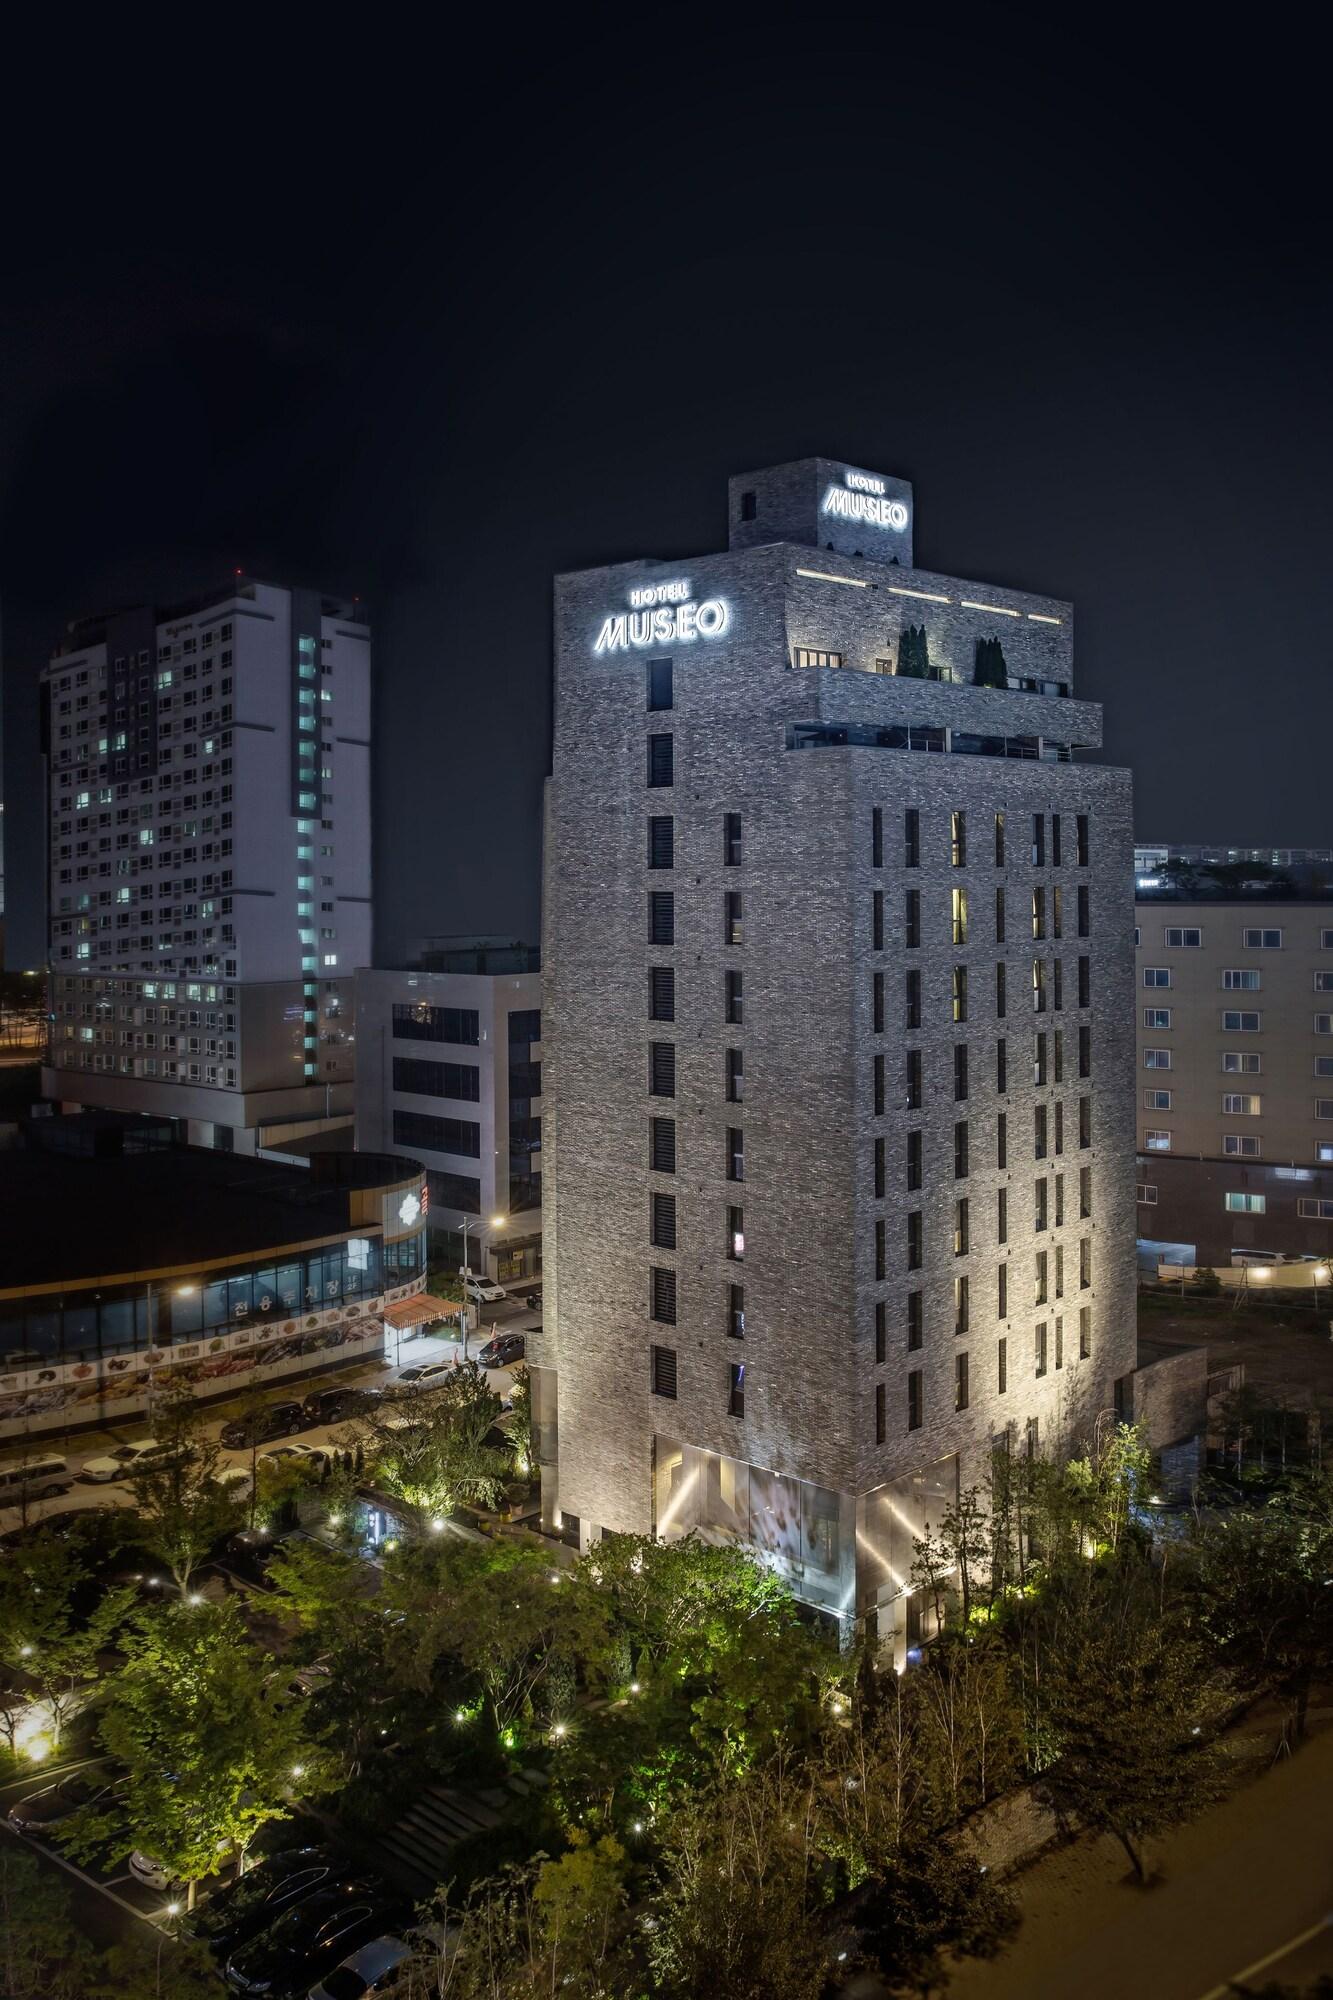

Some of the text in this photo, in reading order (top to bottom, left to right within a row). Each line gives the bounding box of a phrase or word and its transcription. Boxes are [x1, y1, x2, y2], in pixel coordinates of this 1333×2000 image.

[846, 473, 886, 495] HOTEL
[824, 487, 909, 530] MUSEO
[631, 581, 689, 607] HOTEL
[594, 599, 726, 652] MUSEO
